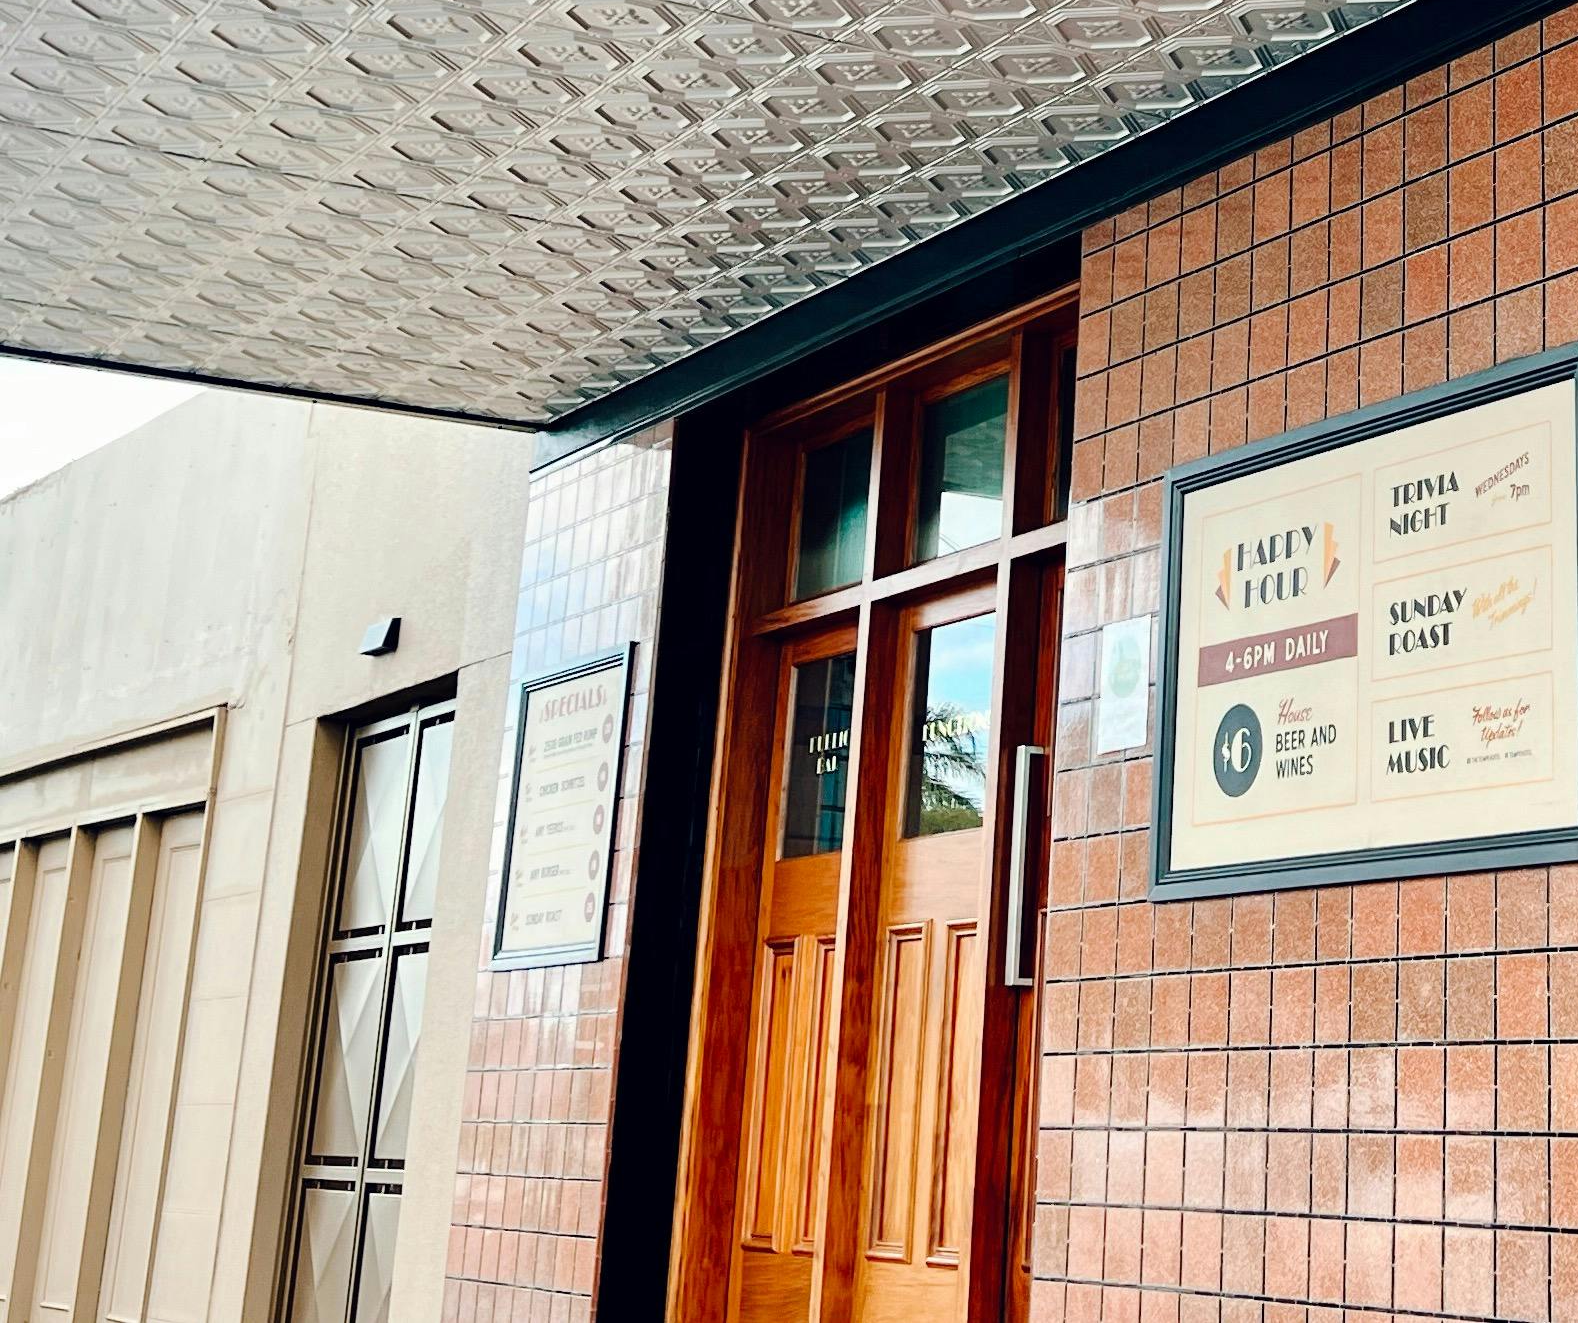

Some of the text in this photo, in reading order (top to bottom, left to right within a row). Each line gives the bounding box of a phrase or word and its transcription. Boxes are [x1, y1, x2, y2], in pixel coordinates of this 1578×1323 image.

[1391, 470, 1460, 507] TRIVIA
[1475, 451, 1529, 498] WEDNESDAYS
[1510, 483, 1531, 502] 7pm
[1389, 502, 1450, 538] NIGHT
[1237, 522, 1318, 572] HAPPY
[1244, 566, 1308, 609] HOUR
[1389, 586, 1467, 626] SUNDAY
[1225, 629, 1329, 673] 4-6PM DAILY
[1389, 621, 1453, 656] ROAST
[544, 684, 602, 722] SPECIALS
[1277, 698, 1313, 725] House
[1472, 705, 1501, 726] Follow
[1275, 724, 1337, 753] BEER AND
[1389, 714, 1435, 744] LIVE
[1221, 727, 1252, 774] $6
[1276, 754, 1314, 779] WINES
[1386, 744, 1451, 776] MUSIC
